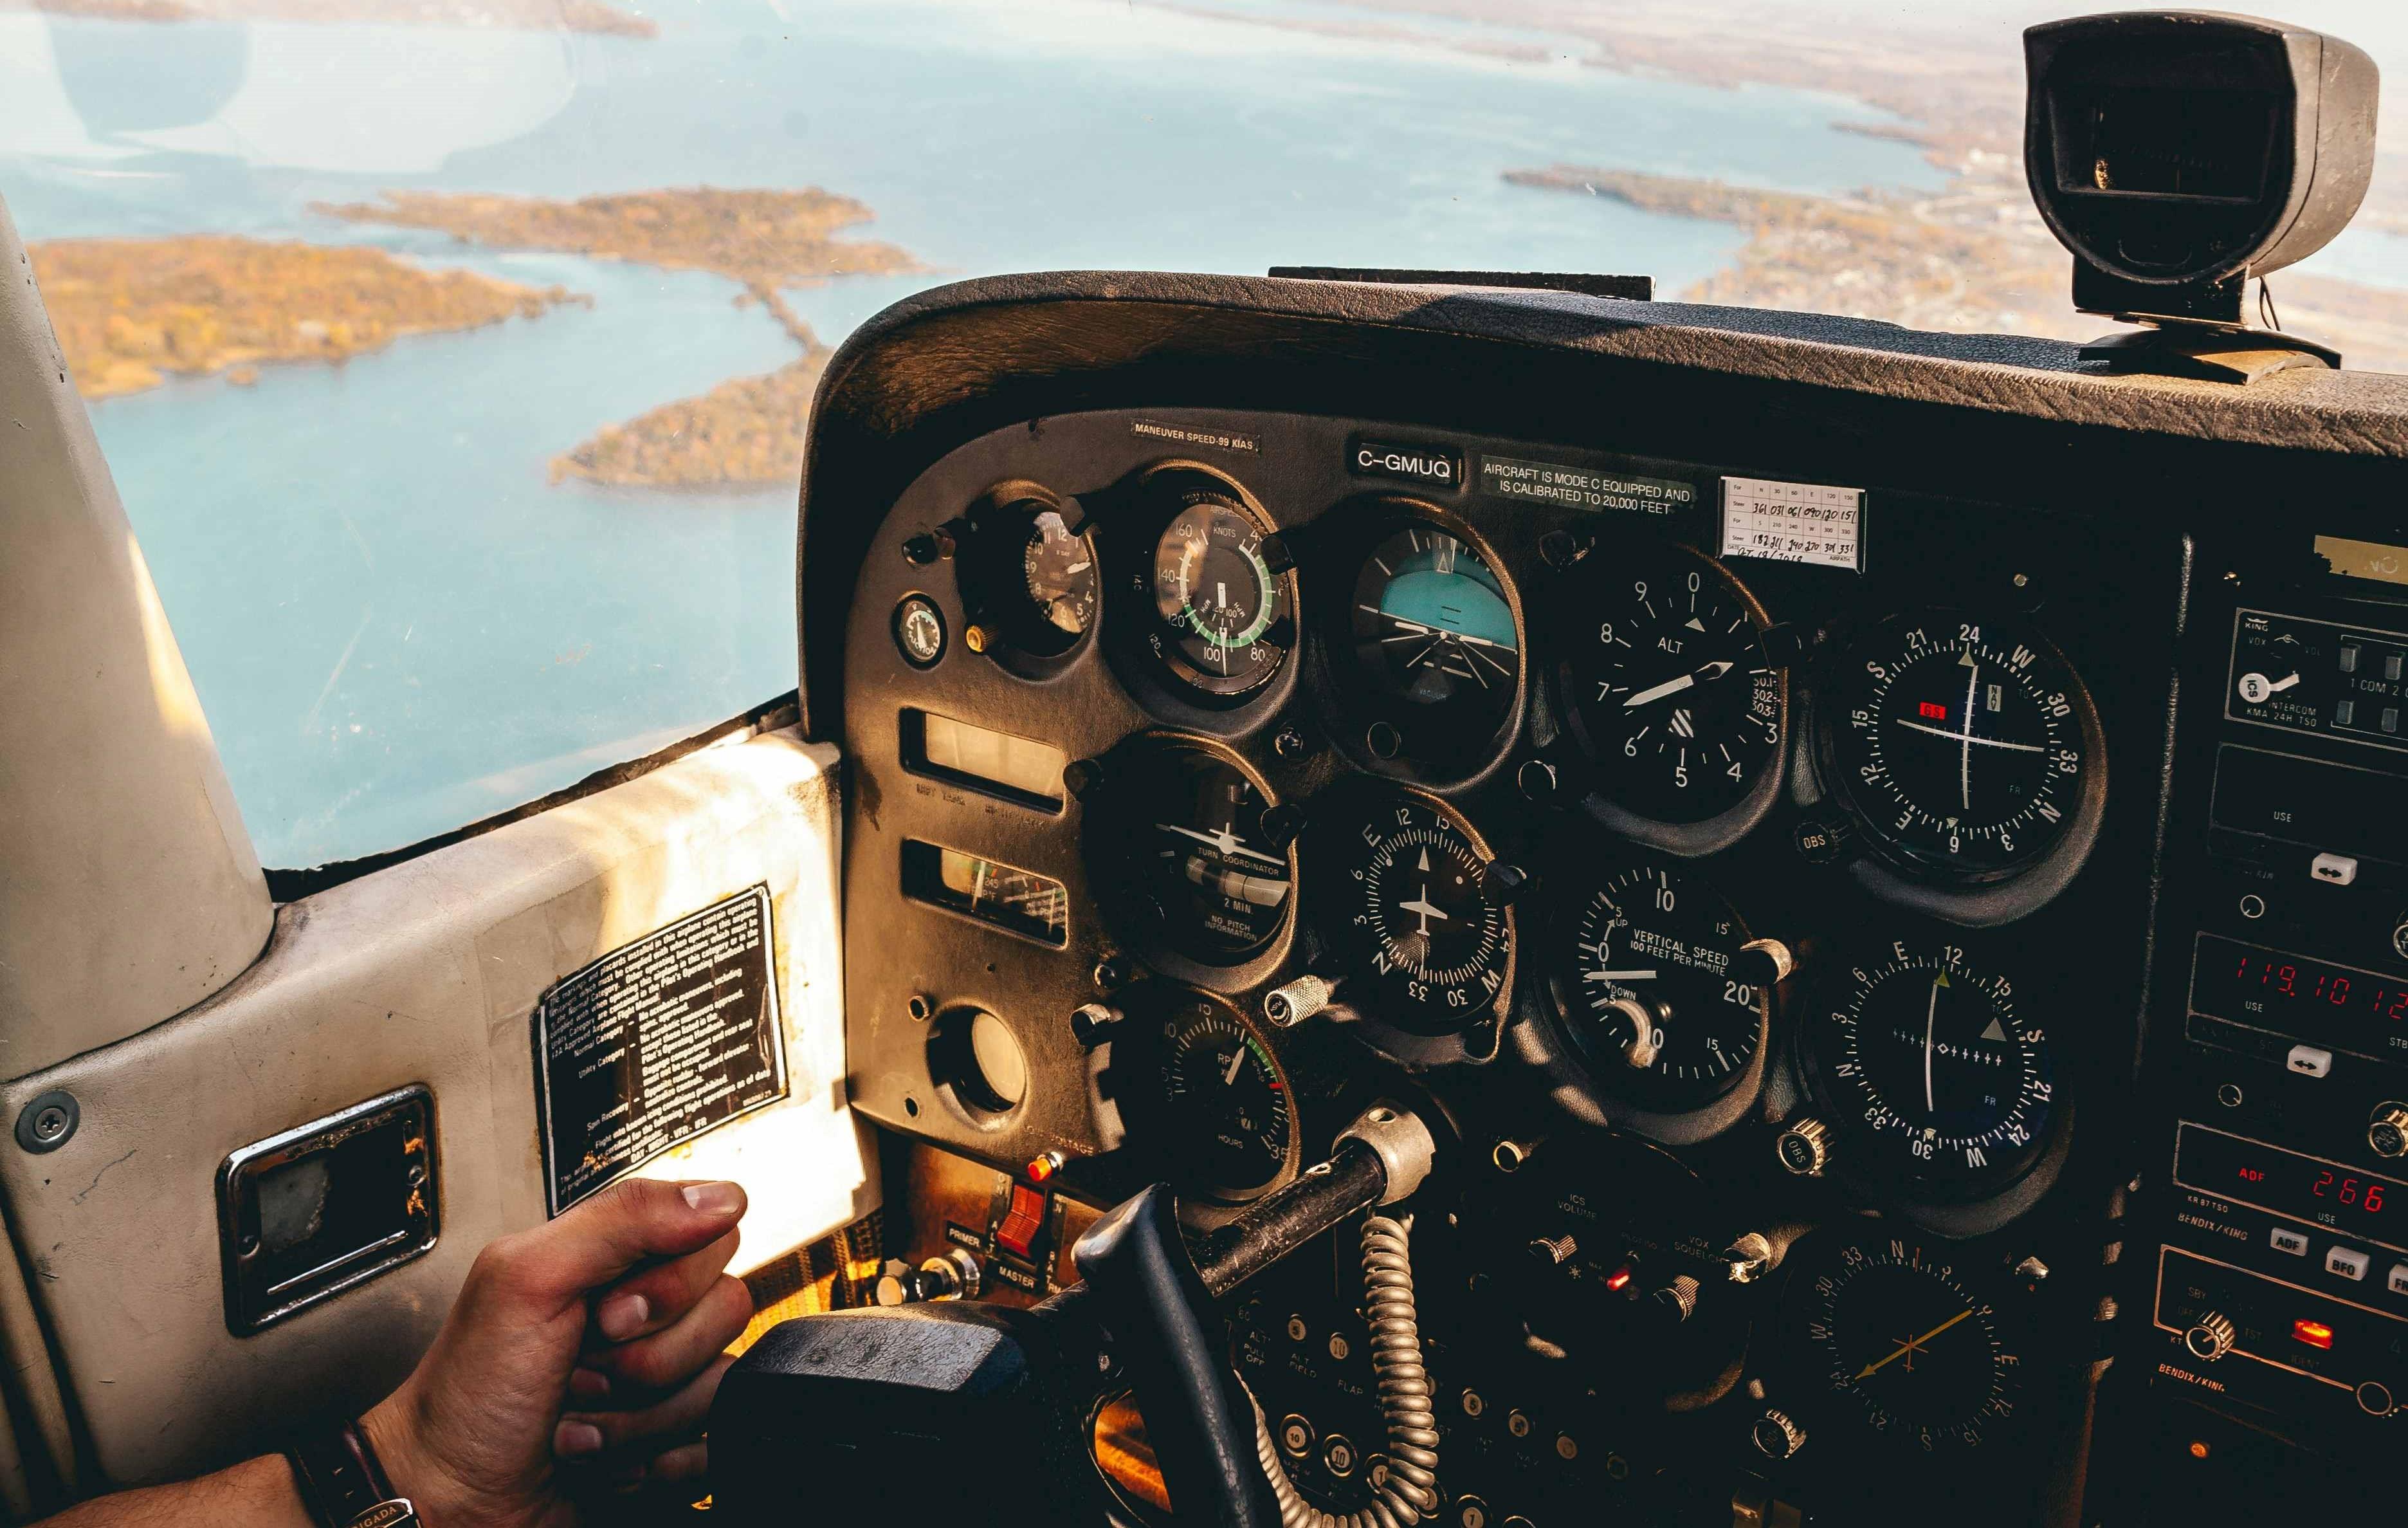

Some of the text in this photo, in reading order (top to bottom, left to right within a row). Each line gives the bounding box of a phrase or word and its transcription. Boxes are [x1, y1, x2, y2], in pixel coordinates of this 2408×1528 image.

[1135, 423, 1184, 440] MANEUVER
[1232, 439, 1253, 450] KIAS
[1358, 450, 1450, 478] C-GMUQ
[1484, 463, 1690, 502] AIRCRAFT IS MODE C EQUIPPED AND
[1500, 481, 1671, 515] IS CALIBRATED TO 20,000 FEET
[1175, 524, 1192, 537] 160
[1213, 525, 1236, 538] KNOTS
[1158, 569, 1175, 583] 140
[1688, 572, 1700, 593] 0
[1634, 581, 1647, 602] 9
[1167, 613, 1185, 628] 120
[2244, 623, 2269, 632] KING
[1601, 623, 1612, 644] 8
[1906, 627, 1928, 649] 21
[1958, 623, 1980, 643] 24
[2248, 637, 2267, 647] VOX
[1203, 647, 1221, 662] 100
[1250, 647, 1266, 661] 80
[1657, 636, 1683, 654] ALT
[2011, 643, 2037, 670] W
[1866, 660, 1886, 679] S
[1597, 681, 1610, 702] 7
[2247, 679, 2258, 698] ICS
[2360, 682, 2387, 694] COM
[2047, 692, 2071, 717] 30
[2268, 701, 2317, 716] INTERCOM
[1851, 710, 1868, 730] 15
[2247, 707, 2317, 728] KMA 24H TSO
[1764, 722, 1778, 744] 3
[1625, 737, 1637, 757] 6
[2059, 749, 2079, 774] 33
[1675, 766, 1688, 787] 5
[1726, 762, 1743, 782] 4
[1860, 762, 1881, 786] 12
[1396, 809, 1412, 826] 12
[1895, 809, 1914, 831] E
[2038, 800, 2062, 824] N
[2273, 811, 2292, 823] USE
[1362, 824, 1382, 848] E
[1803, 834, 1826, 849] OBS
[1198, 847, 1280, 877] TURN COORDINATOR
[1233, 901, 1253, 914] MIN.
[1656, 888, 1675, 912] 10
[1211, 915, 1251, 932] NO PITCH
[1353, 914, 1367, 926] 3
[1615, 917, 1628, 928] UP
[1205, 921, 1257, 943] INFORMATION
[1598, 941, 1609, 962] 0
[1633, 928, 1729, 966] VERTICAL SPEED
[1893, 941, 1909, 961] E
[1944, 945, 1964, 965] 12
[1630, 940, 1726, 977] 100 FEET PER MINUTE
[1409, 980, 1429, 1002] 33
[1611, 985, 1637, 1001] DOWN
[1724, 980, 1750, 1006] 20
[1994, 975, 2012, 997] 15
[1447, 988, 1469, 1008] 30
[2245, 1000, 2264, 1013] USE
[1831, 1013, 1848, 1024] 3
[1706, 1037, 1719, 1051] 15
[1835, 1063, 1856, 1078] N
[2032, 1080, 2052, 1102] 21
[1864, 1107, 1887, 1130] 33
[1218, 1133, 1245, 1149] HOURS
[2007, 1123, 2031, 1148] 24
[1788, 1139, 1806, 1163] OBS
[1911, 1140, 1933, 1161] 30
[1966, 1146, 1988, 1169] W
[2238, 1166, 2265, 1183] ADF
[1569, 1193, 1586, 1206] ICS
[2311, 1170, 2387, 1213] 266
[1556, 1199, 1597, 1220] VOLUME
[2317, 1212, 2337, 1225] USE
[2177, 1212, 2248, 1241] BENDIX/KING
[949, 1228, 980, 1247] PRIMER
[1688, 1235, 1710, 1250] VOX
[2276, 1236, 2300, 1251] ADF
[1674, 1242, 1722, 1265] SQUELCH
[999, 1266, 1035, 1289] MASTER
[2331, 1259, 2355, 1276] BFO
[1289, 1361, 1318, 1380] FIELD
[1338, 1378, 1364, 1396] FLAP
